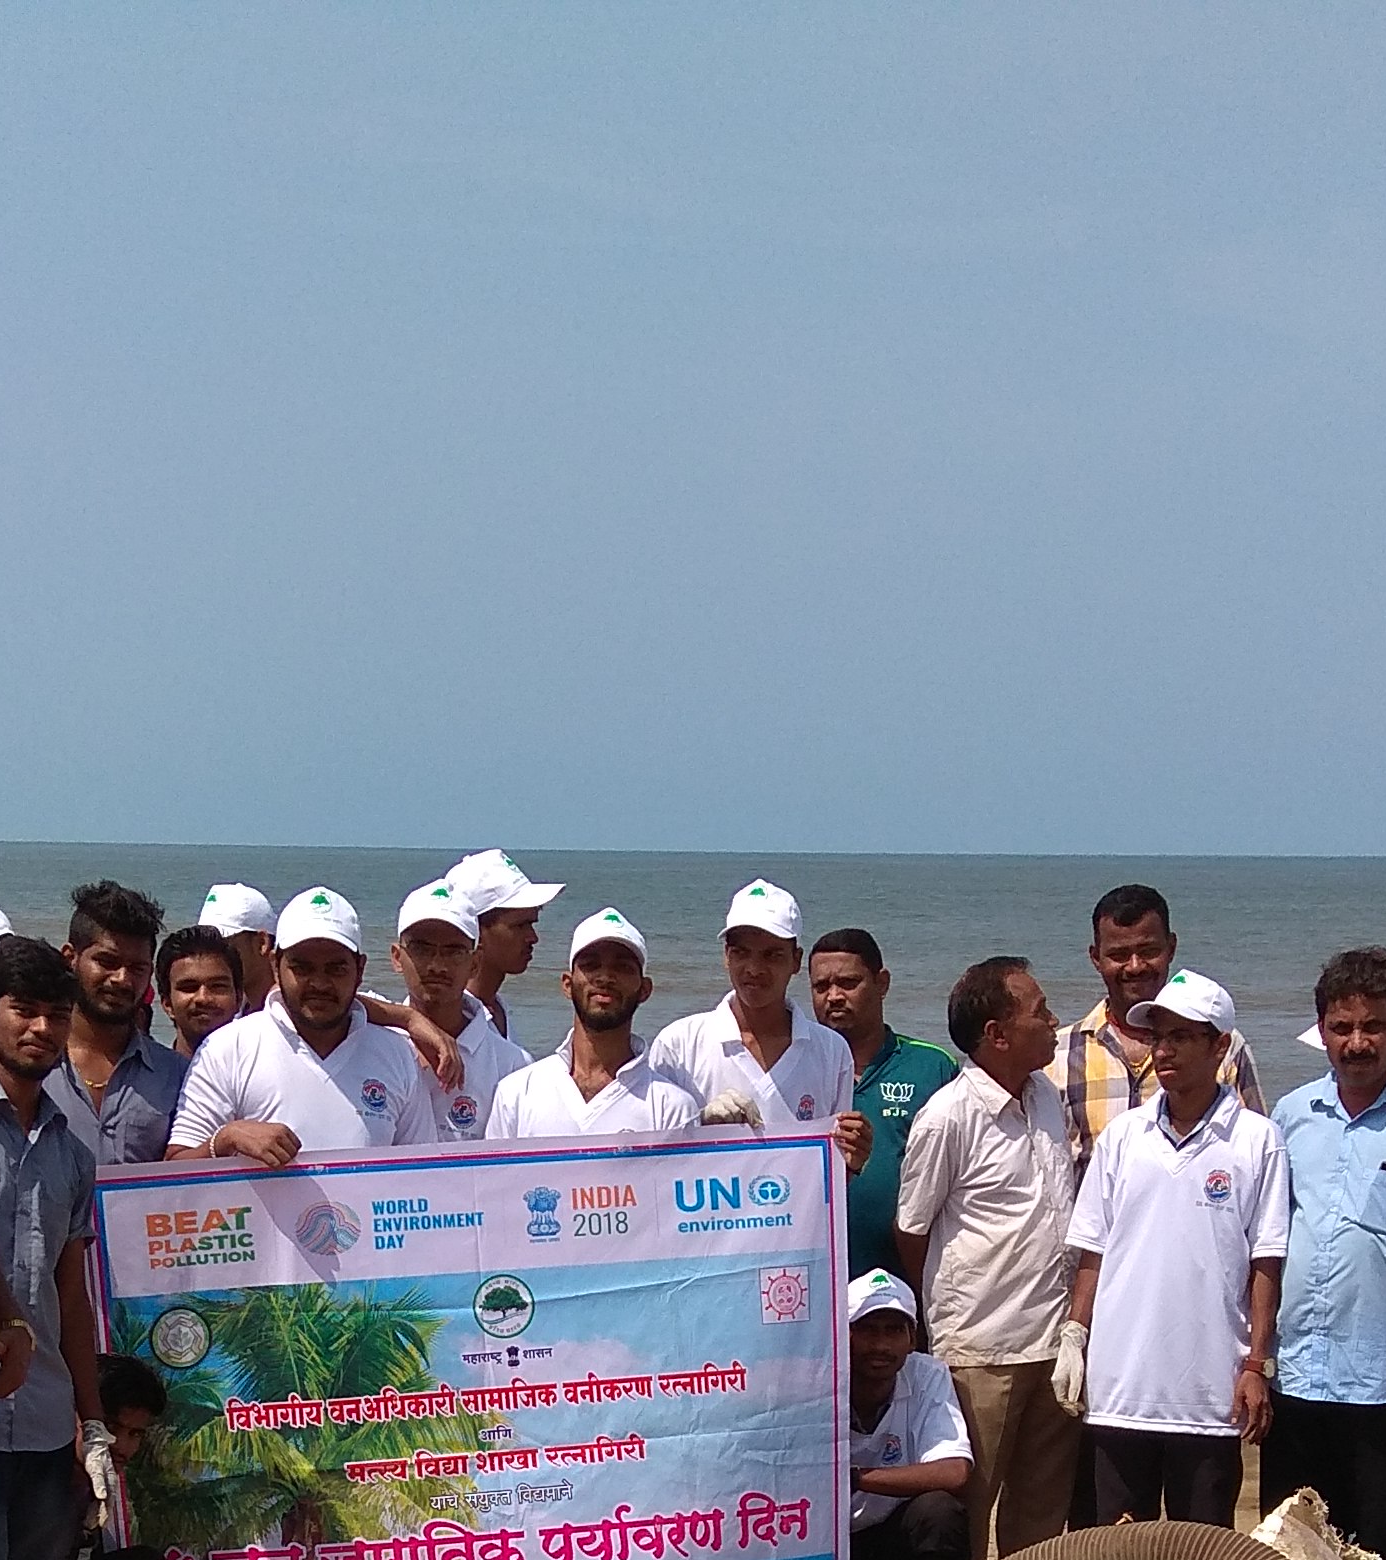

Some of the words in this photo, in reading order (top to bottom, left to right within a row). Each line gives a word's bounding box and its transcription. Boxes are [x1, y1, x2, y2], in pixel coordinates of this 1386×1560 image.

[883, 1107, 909, 1117] BJP
[571, 1185, 637, 1210] INDIA
[674, 1177, 741, 1213] UN
[372, 1199, 428, 1216] WORLD
[145, 1207, 252, 1237] BEAT
[373, 1212, 484, 1232] ENVIRONMENT
[573, 1211, 629, 1237] 2018
[678, 1212, 793, 1233] environment
[148, 1233, 254, 1255] PLASTIC
[375, 1234, 405, 1250] DAY
[150, 1250, 256, 1269] POLLUTION
[462, 1352, 503, 1365] महाराष्ट्र
[523, 1348, 552, 1359] शासन
[226, 1395, 322, 1431] विभागीय
[328, 1384, 457, 1424] वनअधिकारी
[461, 1377, 557, 1414] सामाजिक
[563, 1371, 653, 1404] वनीकरण
[658, 1360, 747, 1397] रत्नागिरी
[479, 1425, 512, 1441] आणि
[345, 1459, 410, 1482] मत्स्य
[415, 1449, 468, 1479] विद्या
[476, 1448, 539, 1474] शाखा
[544, 1434, 647, 1466] रत्नागिरी
[464, 1487, 512, 1513] संयुक्त
[517, 1479, 573, 1504] विद्यमाने
[737, 1492, 811, 1547] दिन
